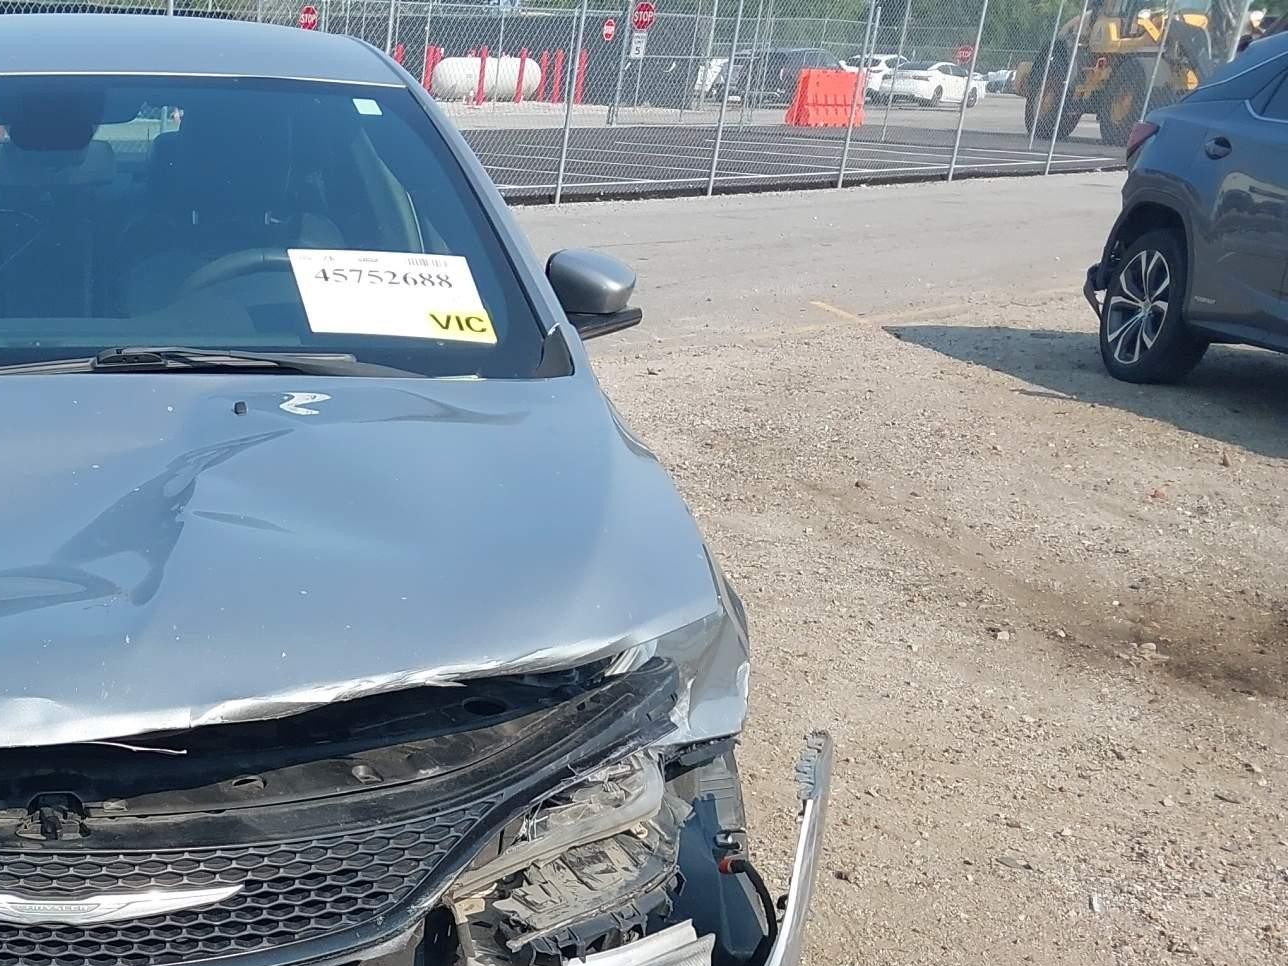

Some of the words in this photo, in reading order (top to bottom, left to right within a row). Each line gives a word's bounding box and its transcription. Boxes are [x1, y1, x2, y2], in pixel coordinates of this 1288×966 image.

[300, 13, 317, 23] STOP
[634, 11, 654, 22] STOP
[634, 46, 641, 55] 5
[314, 268, 453, 288] 45752688
[429, 313, 487, 333] VIC
